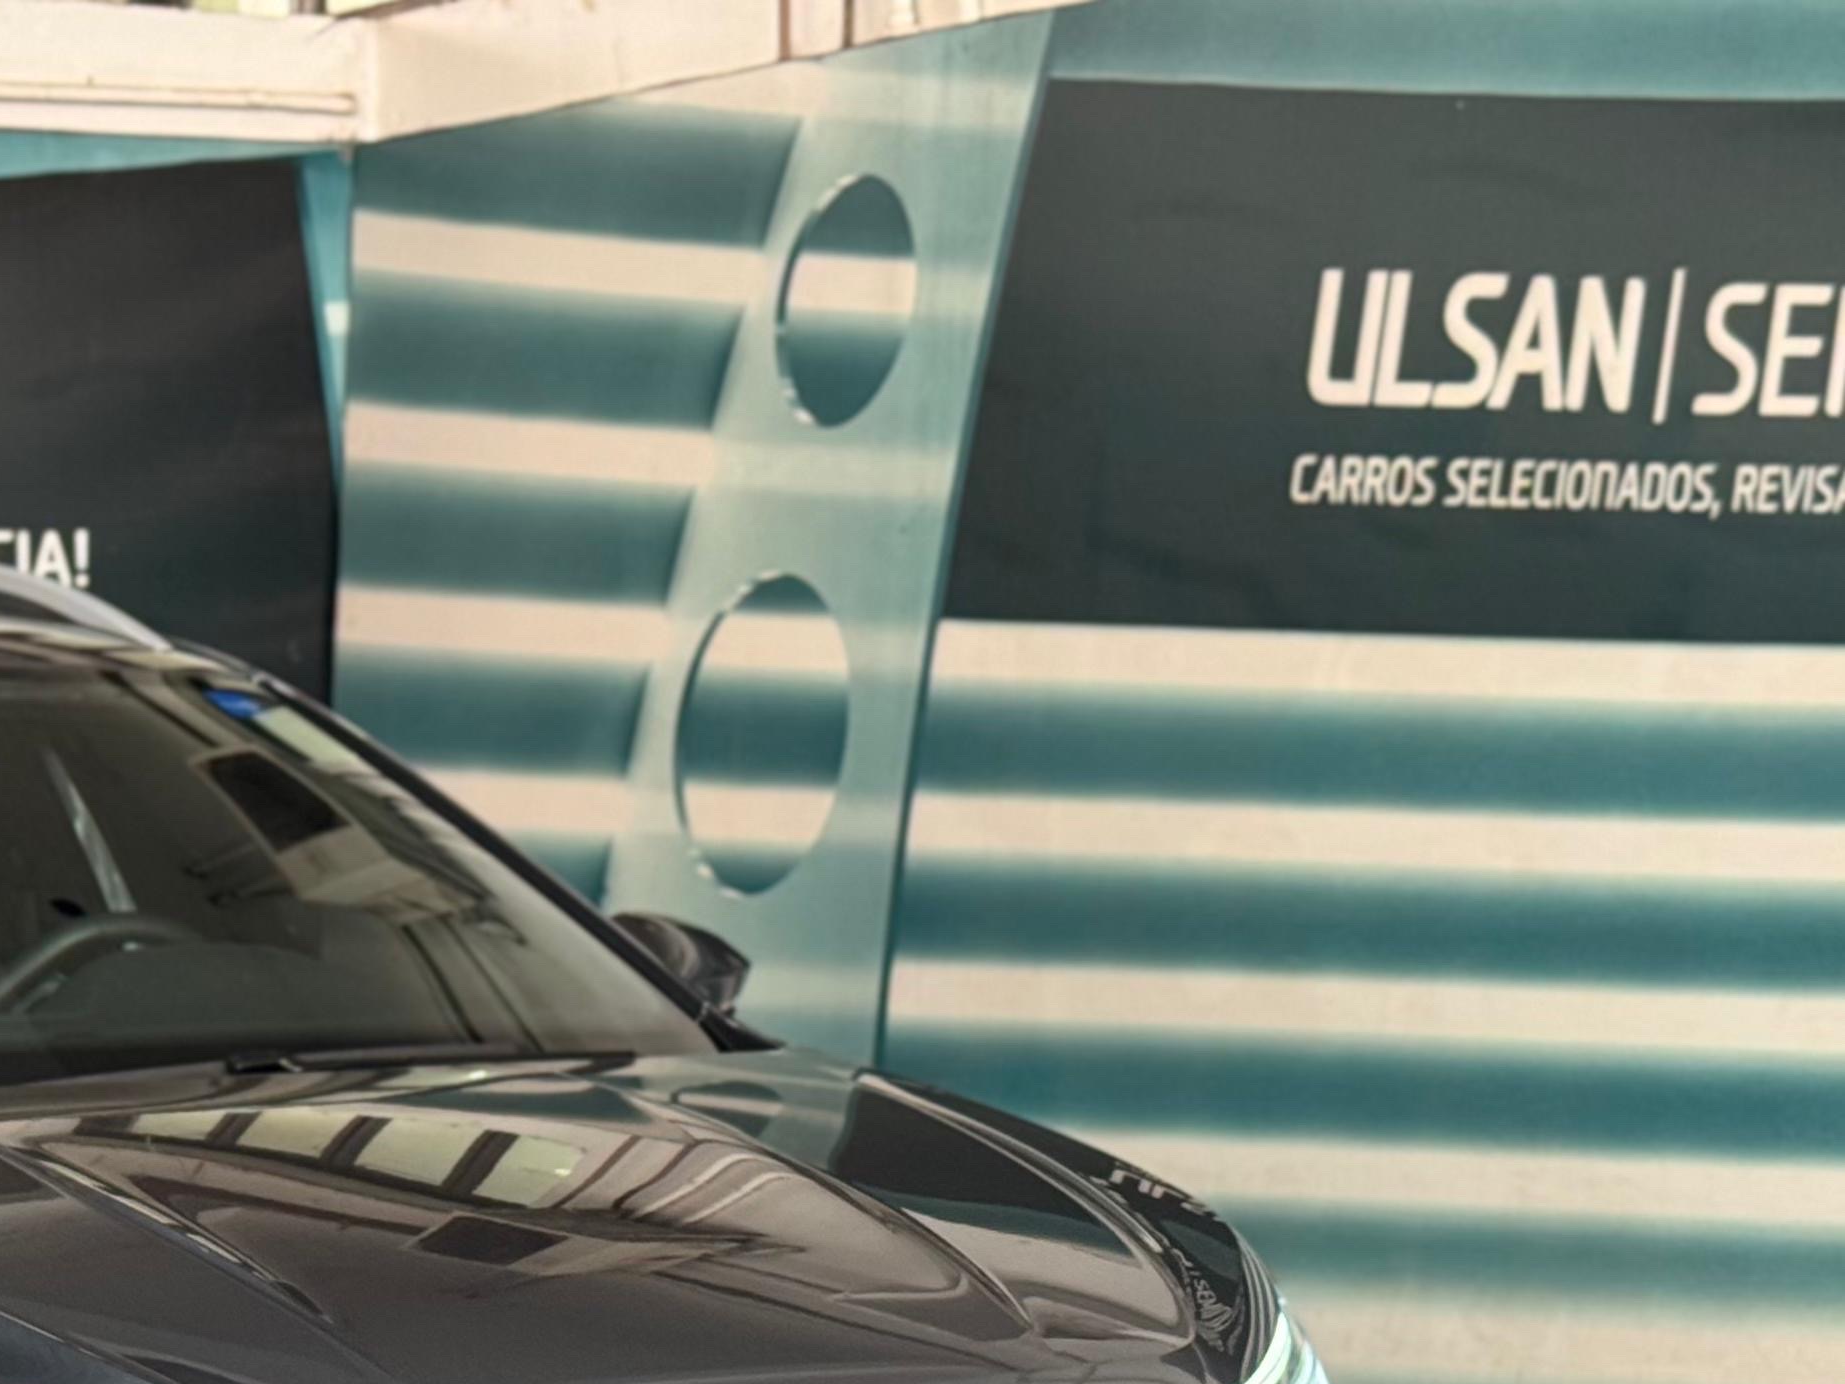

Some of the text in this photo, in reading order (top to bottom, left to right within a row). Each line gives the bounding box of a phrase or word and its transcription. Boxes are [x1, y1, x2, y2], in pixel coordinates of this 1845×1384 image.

[1306, 267, 1845, 418] ULSAN SE
[1289, 453, 1439, 505] CARROS
[1442, 458, 1721, 520] SELECIONADOS,
